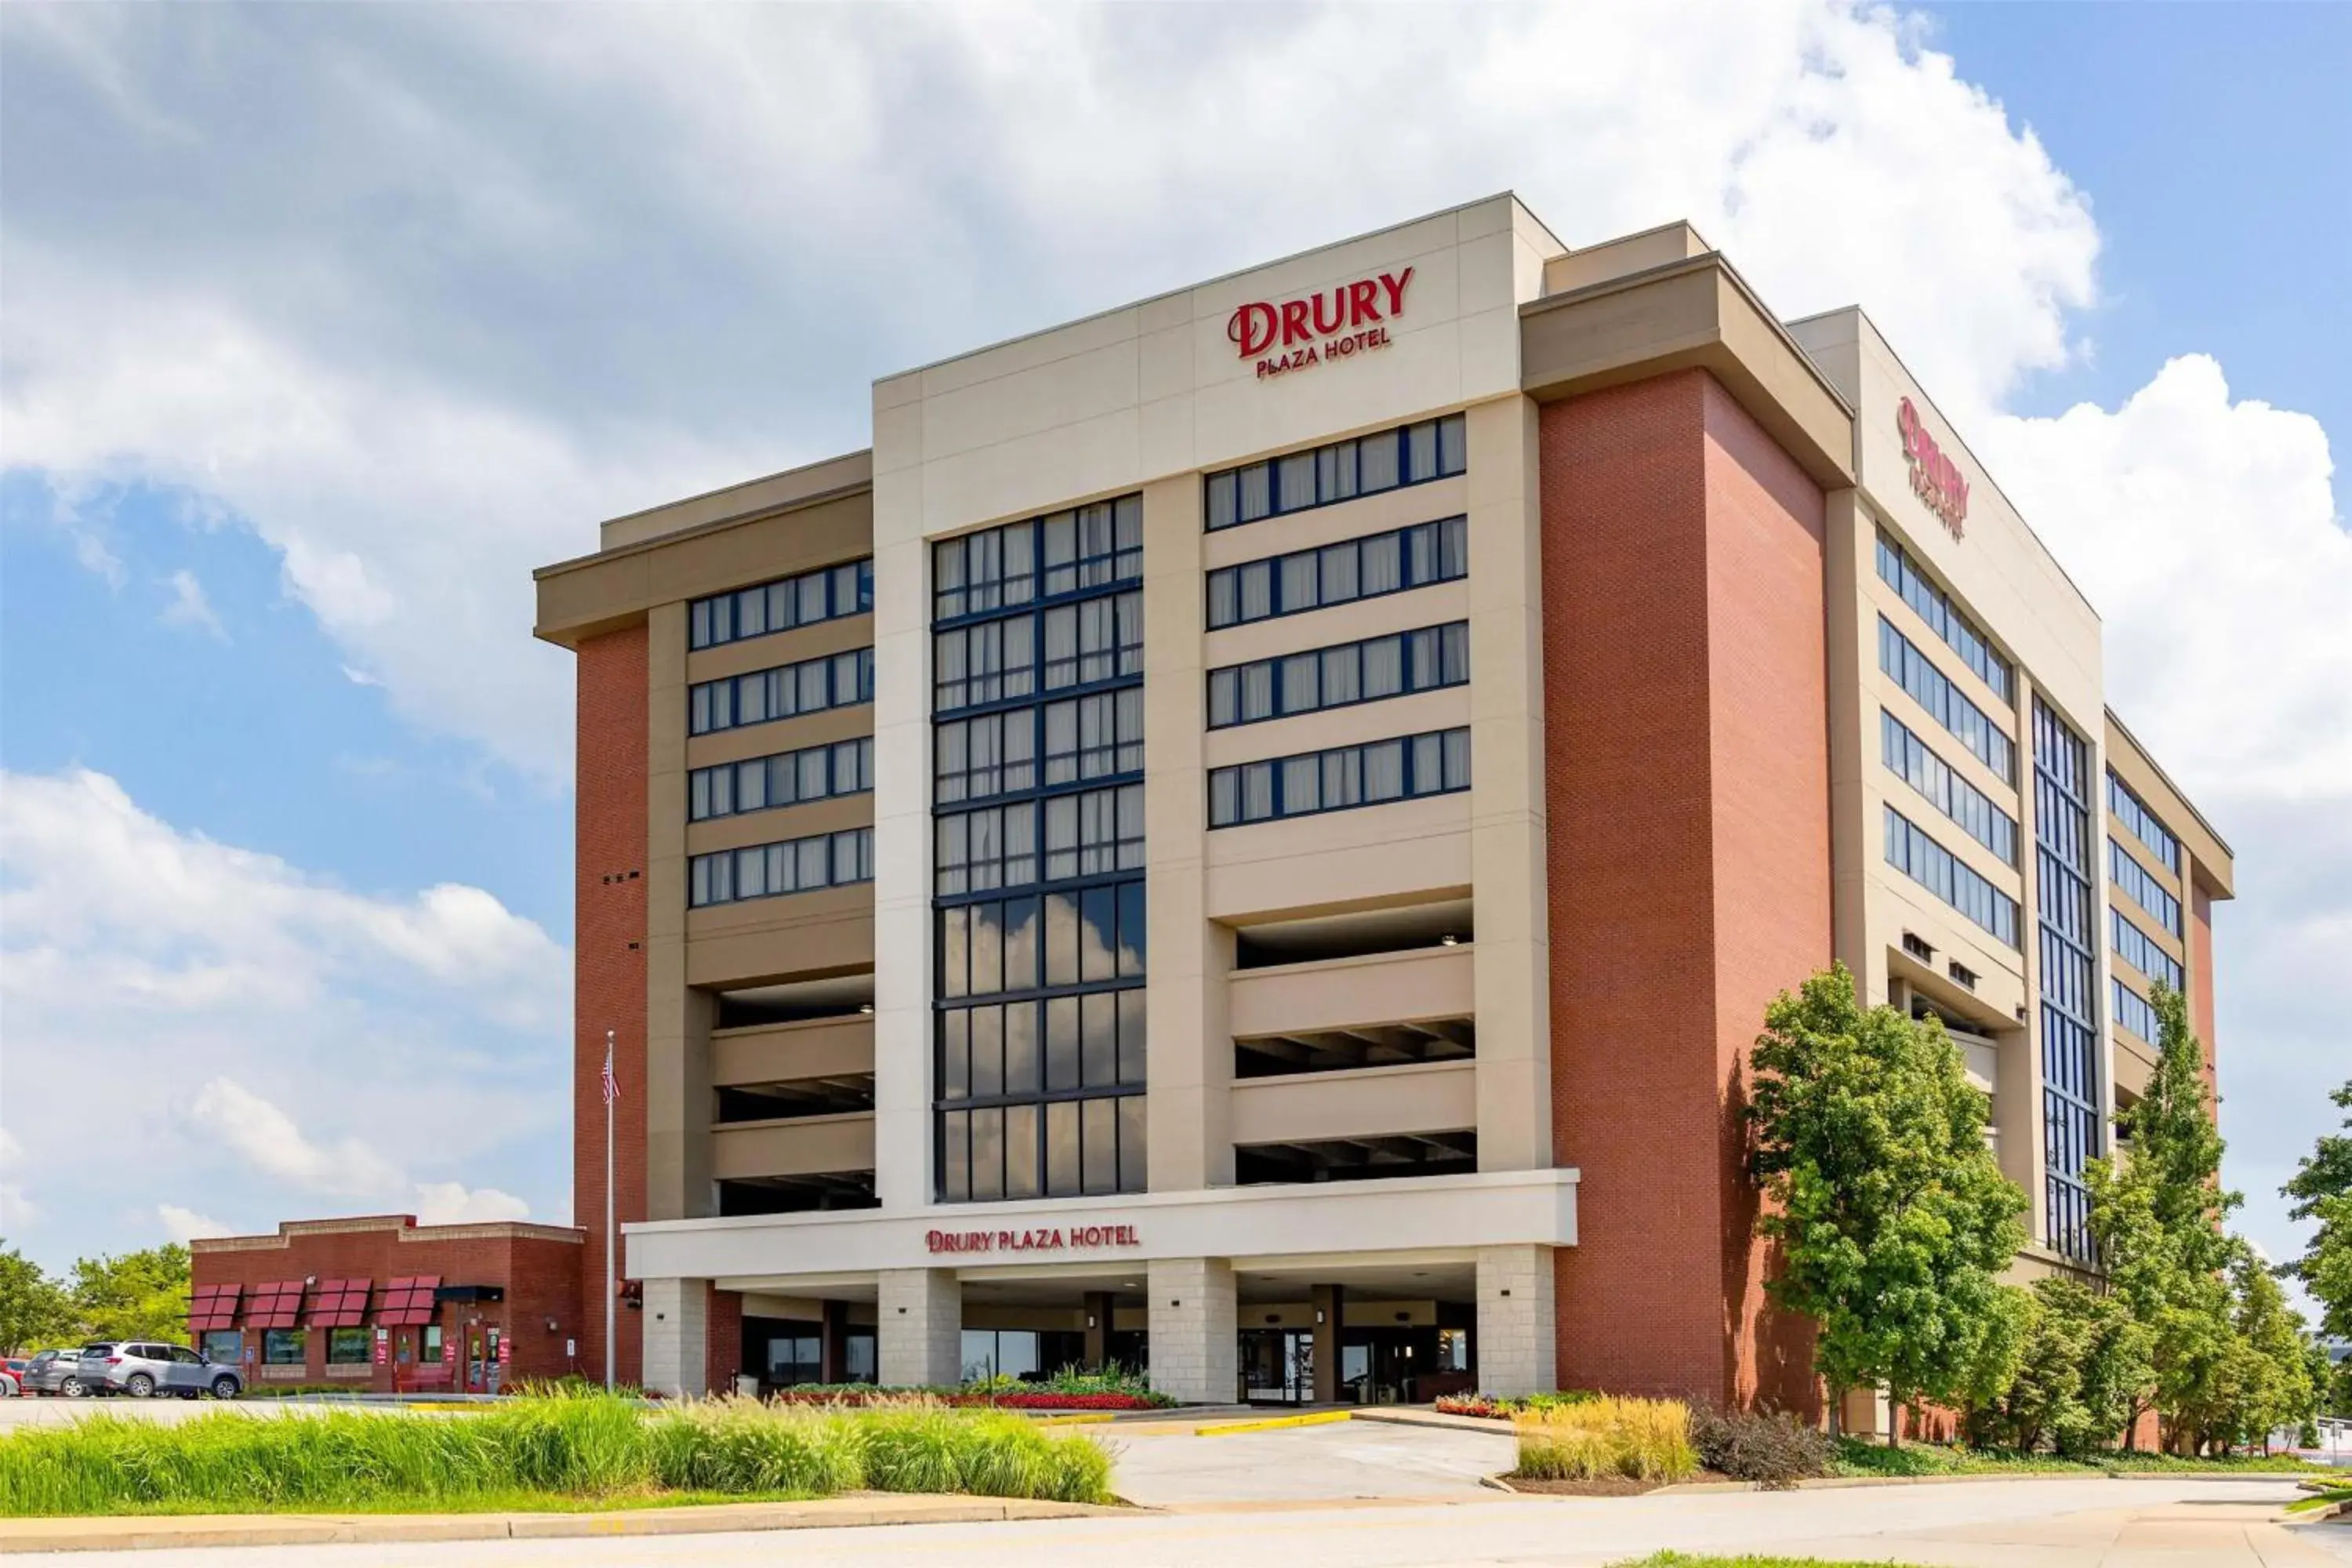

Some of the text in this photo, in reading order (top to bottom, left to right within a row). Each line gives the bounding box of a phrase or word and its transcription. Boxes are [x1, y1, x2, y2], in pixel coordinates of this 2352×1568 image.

[1227, 267, 1414, 358] DRURY
[1257, 328, 1391, 378] PLAZA HOTEL
[924, 1225, 1139, 1253] DRURY PLAZA HOTEL
